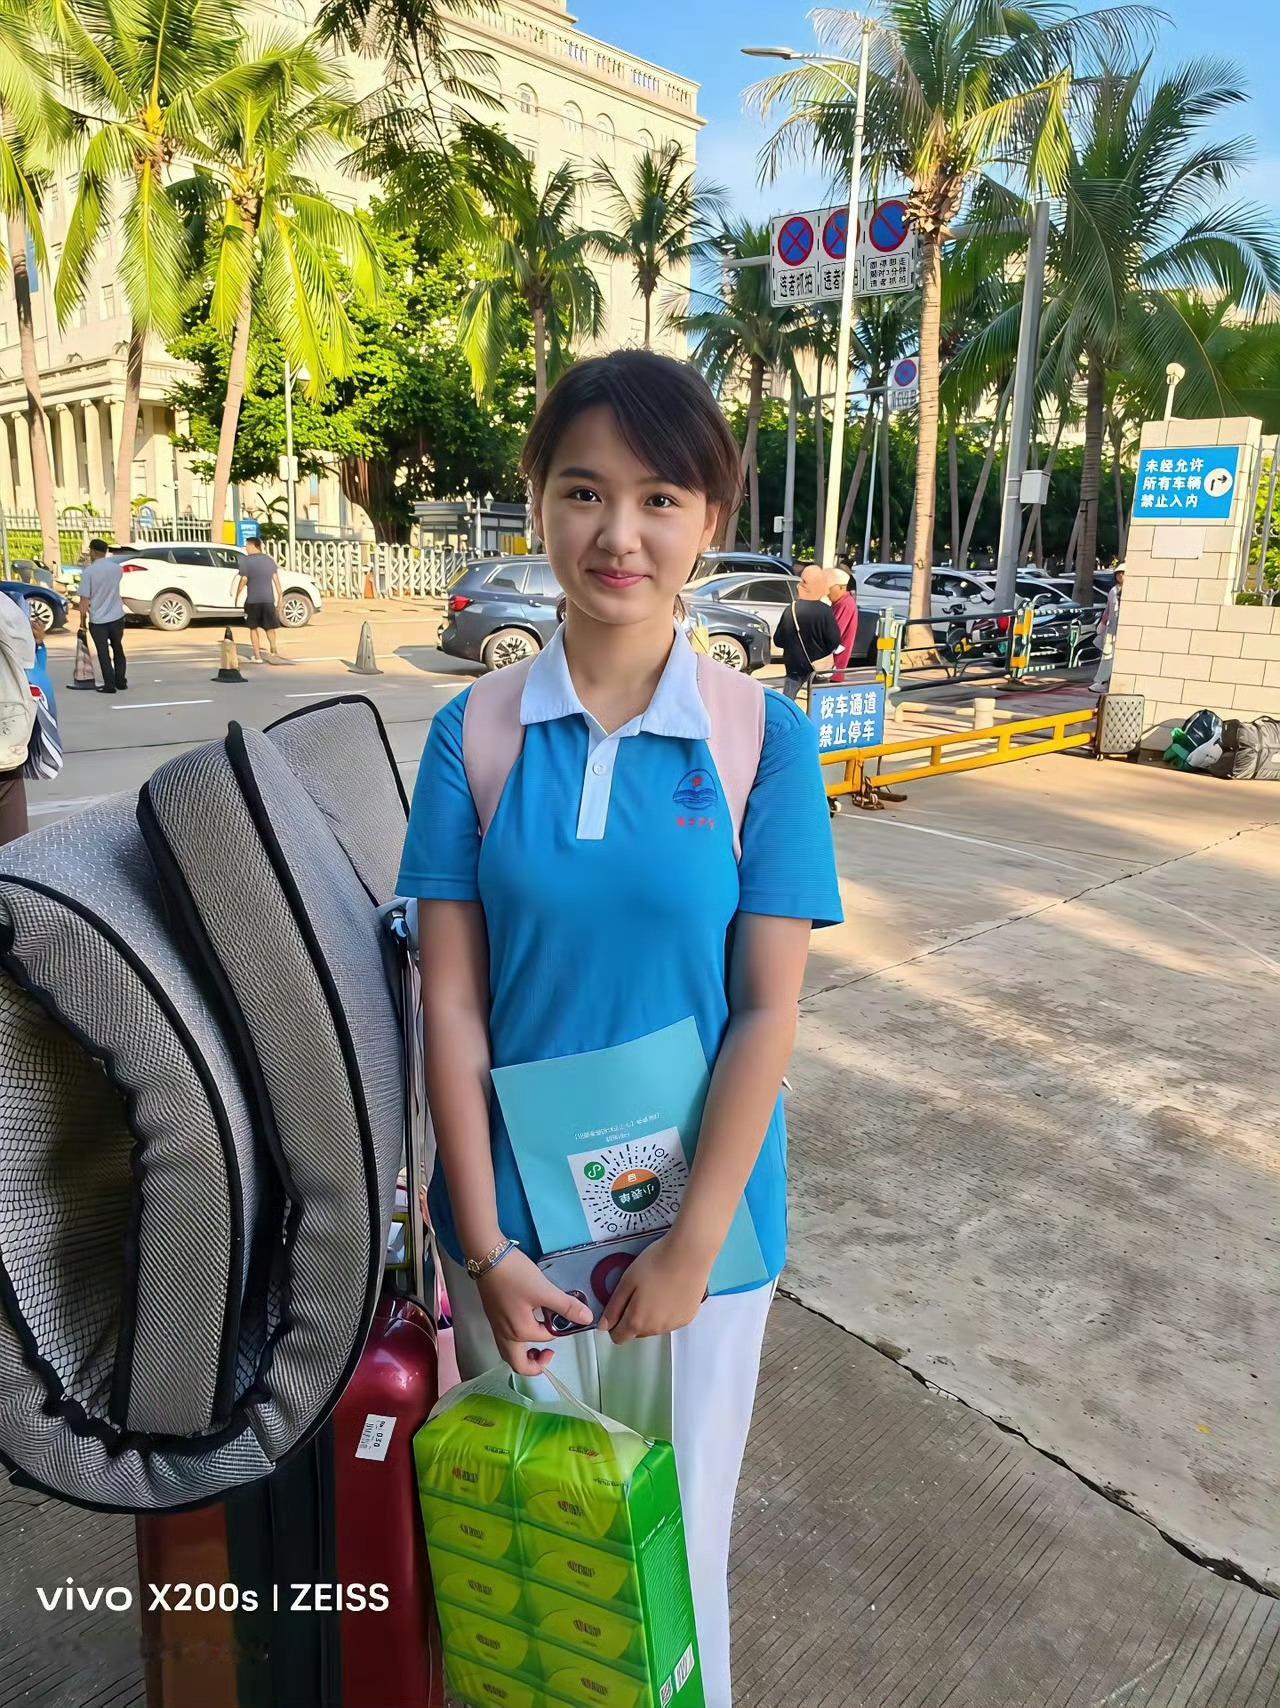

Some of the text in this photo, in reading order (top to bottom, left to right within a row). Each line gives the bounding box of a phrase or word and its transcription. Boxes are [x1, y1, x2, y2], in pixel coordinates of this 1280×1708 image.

[1145, 458, 1204, 473] 未经允许
[1142, 476, 1202, 491] 所有车辆
[1140, 493, 1199, 508] 禁止入内
[821, 691, 877, 719] 校车通道
[819, 718, 876, 748] 禁止停车
